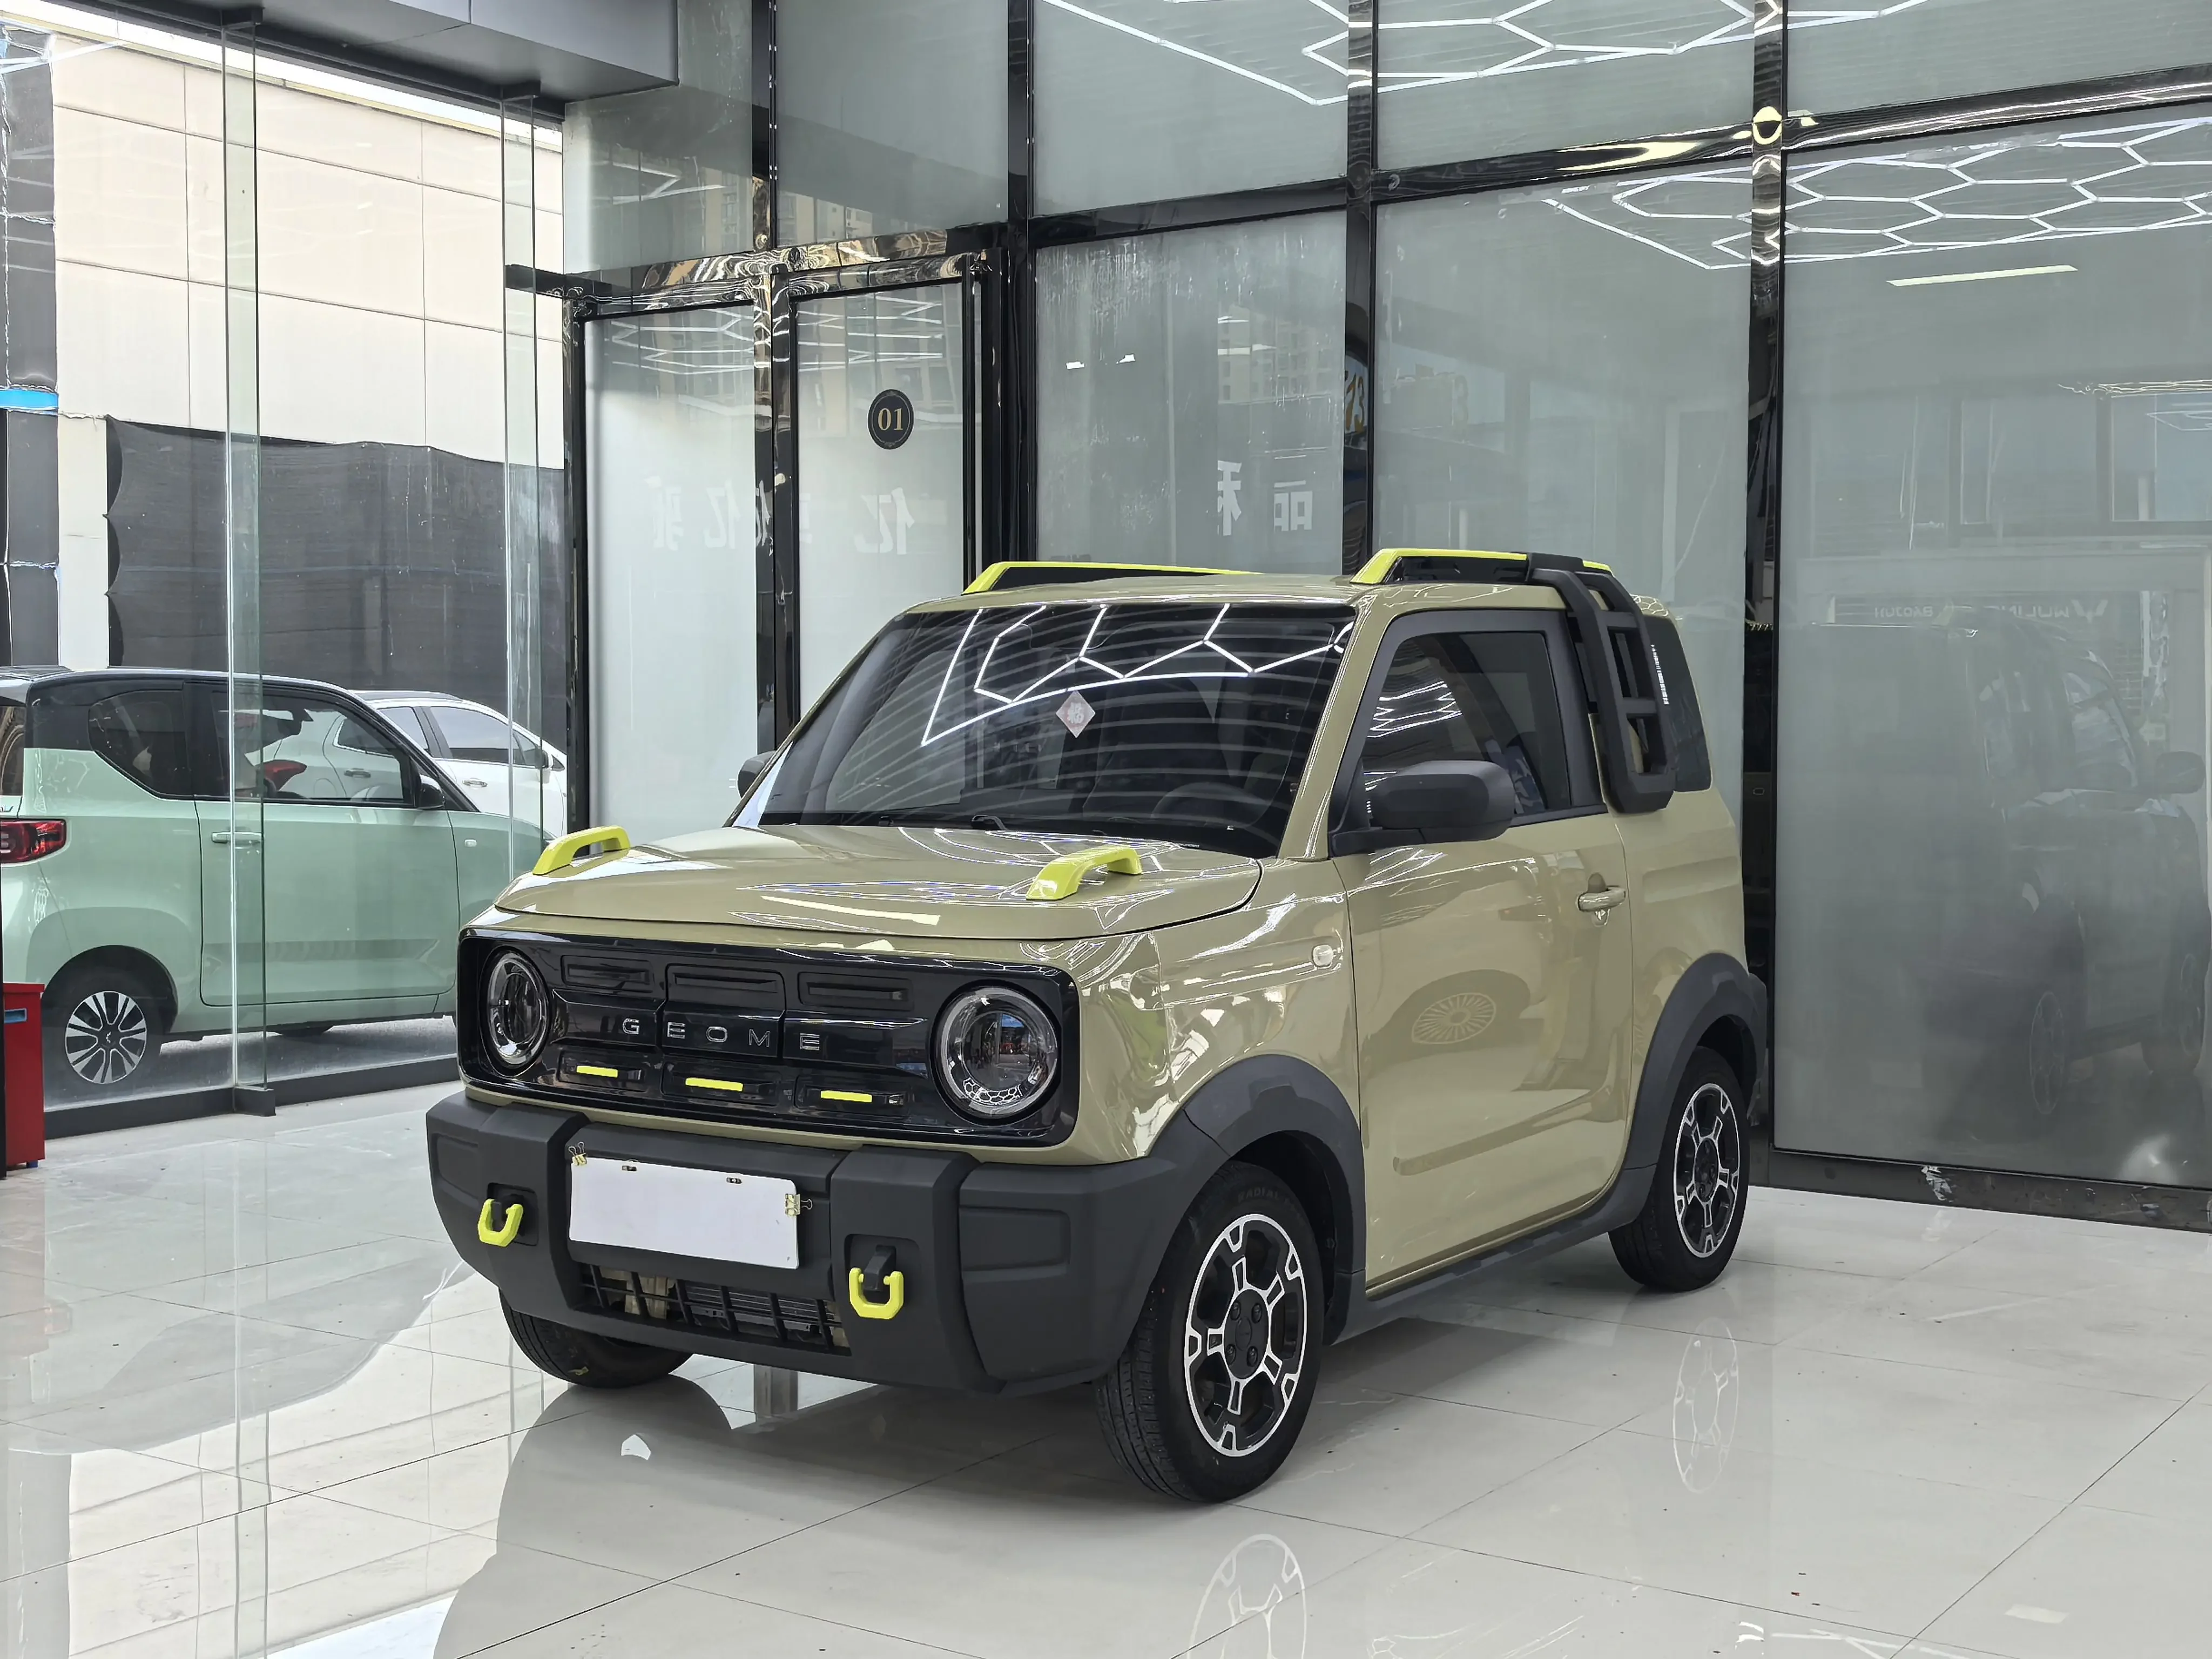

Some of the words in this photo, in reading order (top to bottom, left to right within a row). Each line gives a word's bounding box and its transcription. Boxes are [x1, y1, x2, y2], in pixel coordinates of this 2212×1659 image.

[878, 408, 903, 430] 01
[622, 1018, 820, 1051] GEOME
[1238, 1187, 1279, 1203] RADIAL
